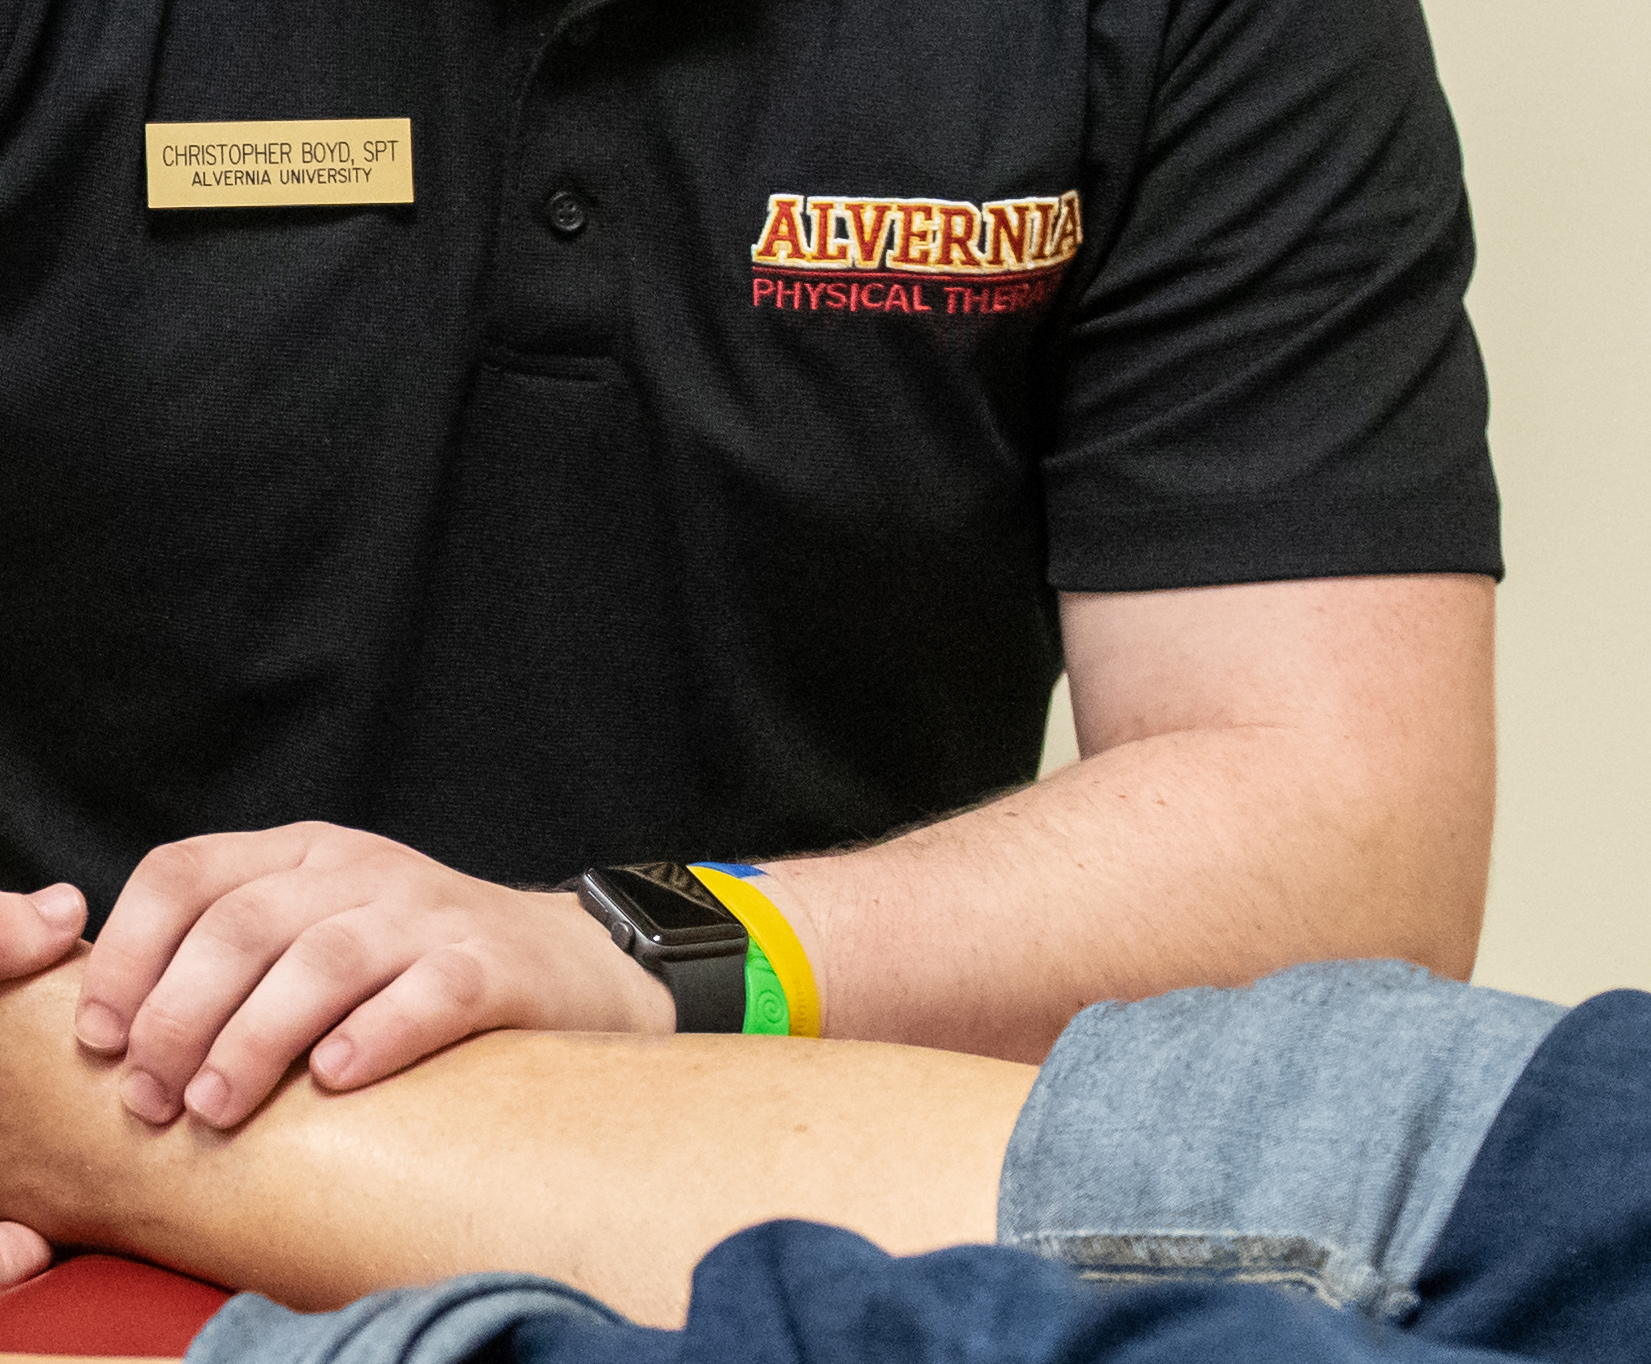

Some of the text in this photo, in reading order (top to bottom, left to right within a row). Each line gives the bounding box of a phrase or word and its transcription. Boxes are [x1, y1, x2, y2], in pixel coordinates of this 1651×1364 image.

[162, 140, 399, 167] CHRISTOPHER BOYD, SPT
[191, 167, 372, 187] ALVERNIA UNIVERSITY
[750, 190, 1083, 275] ALVERNIA
[752, 277, 932, 314] PHYSICAL
